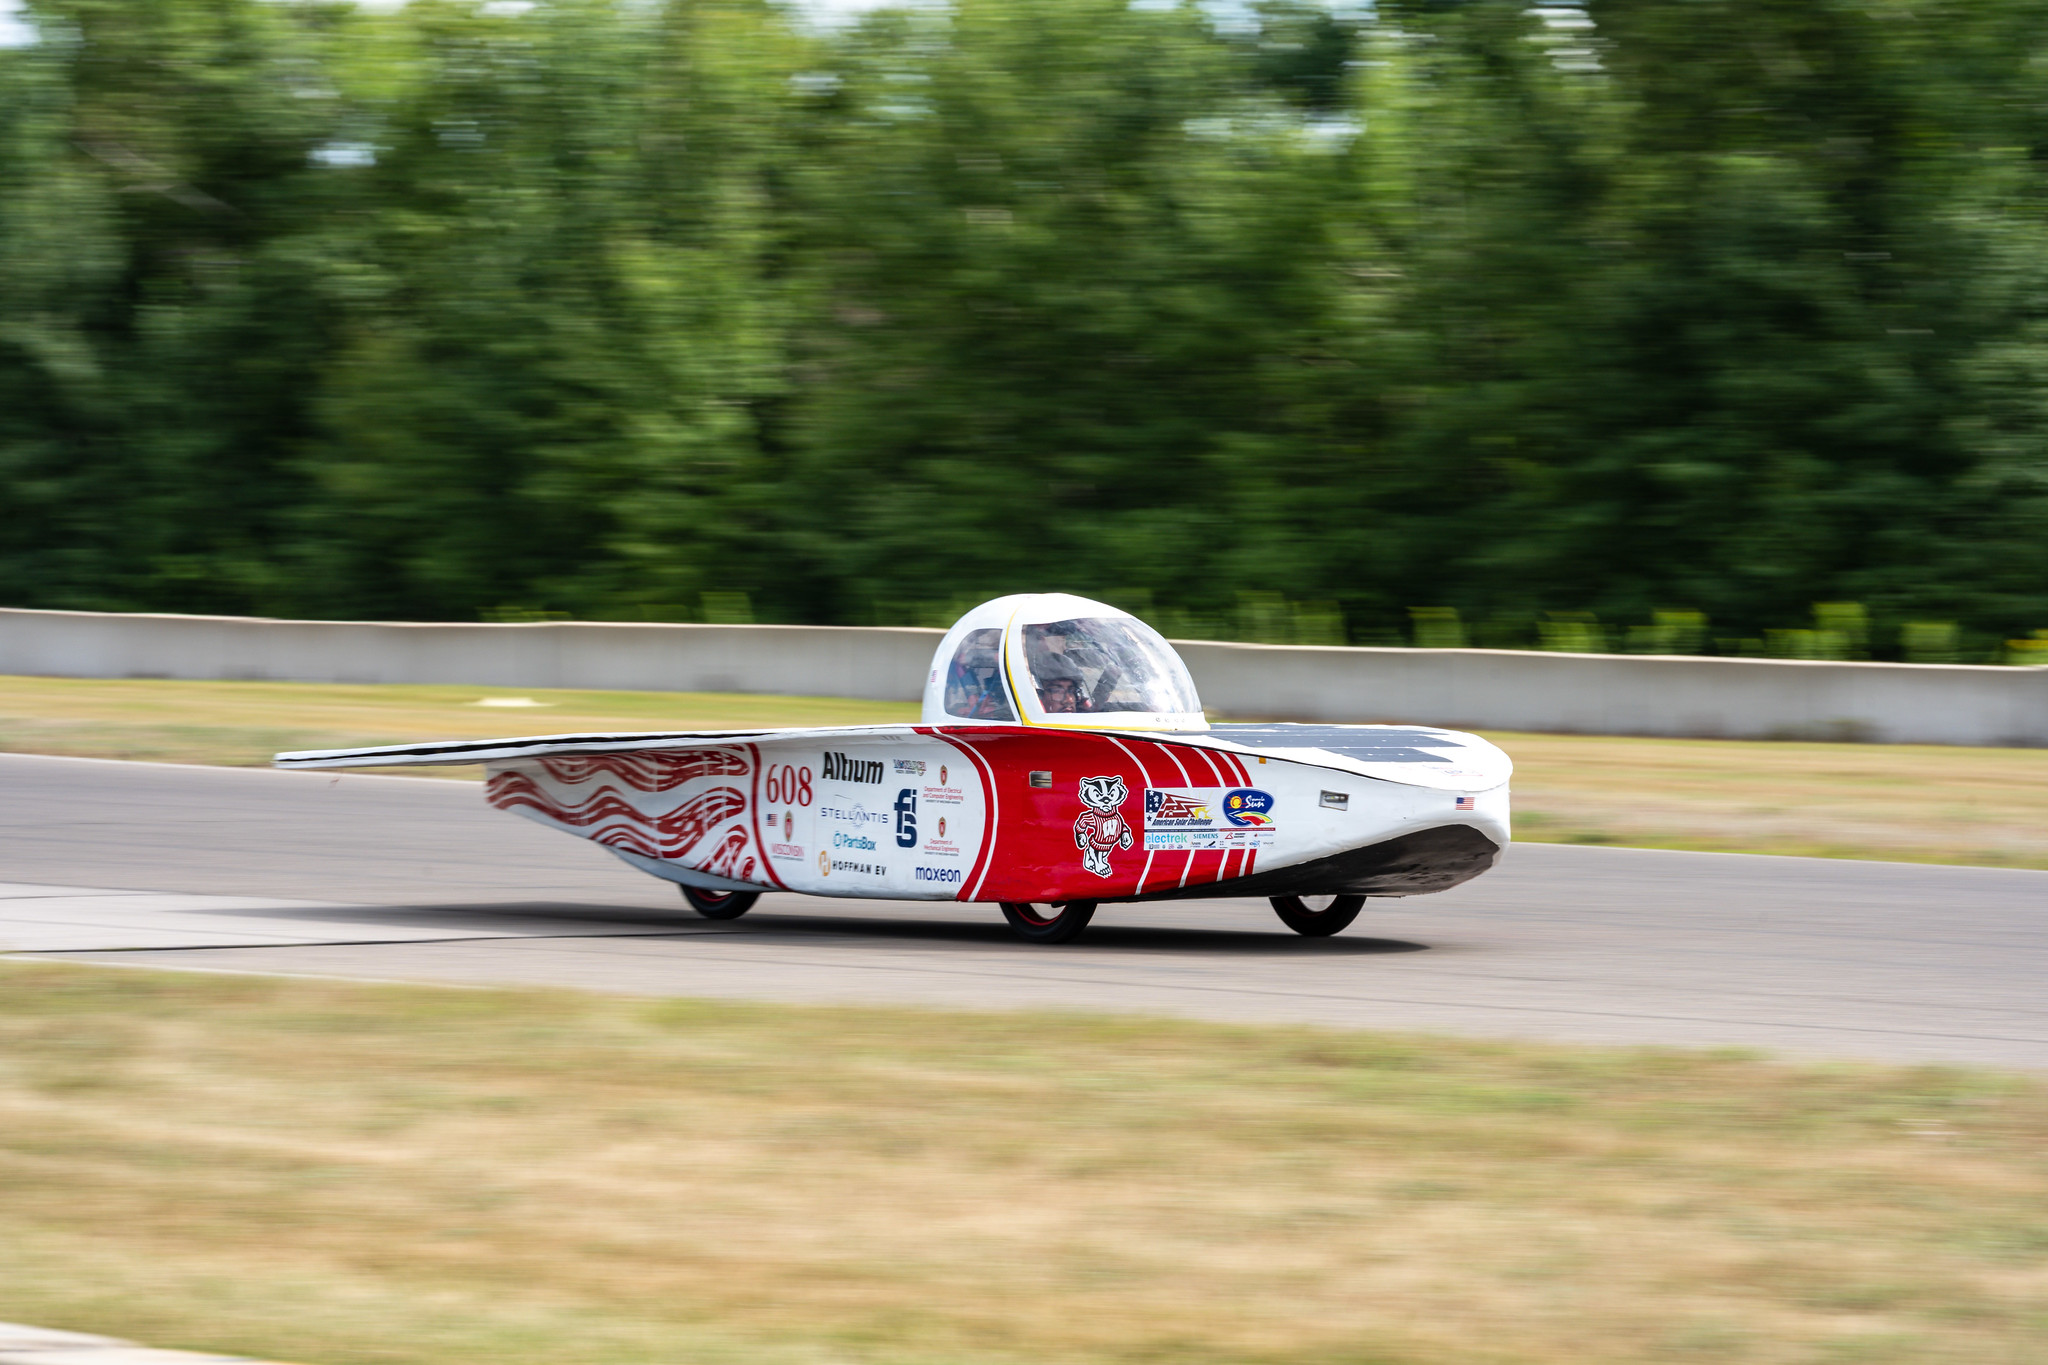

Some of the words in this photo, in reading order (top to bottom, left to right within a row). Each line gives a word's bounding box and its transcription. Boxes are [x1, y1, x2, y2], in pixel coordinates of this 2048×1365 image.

[822, 751, 884, 784] Altium
[766, 764, 812, 807] 608
[821, 808, 888, 823] STELLANTIS
[1187, 818, 1213, 826] Challenge
[843, 834, 876, 851] PartsBox
[1145, 833, 1187, 843] electrek
[832, 860, 872, 874] HOFFMAN
[875, 865, 886, 876] EV
[916, 867, 961, 882] maxeon
